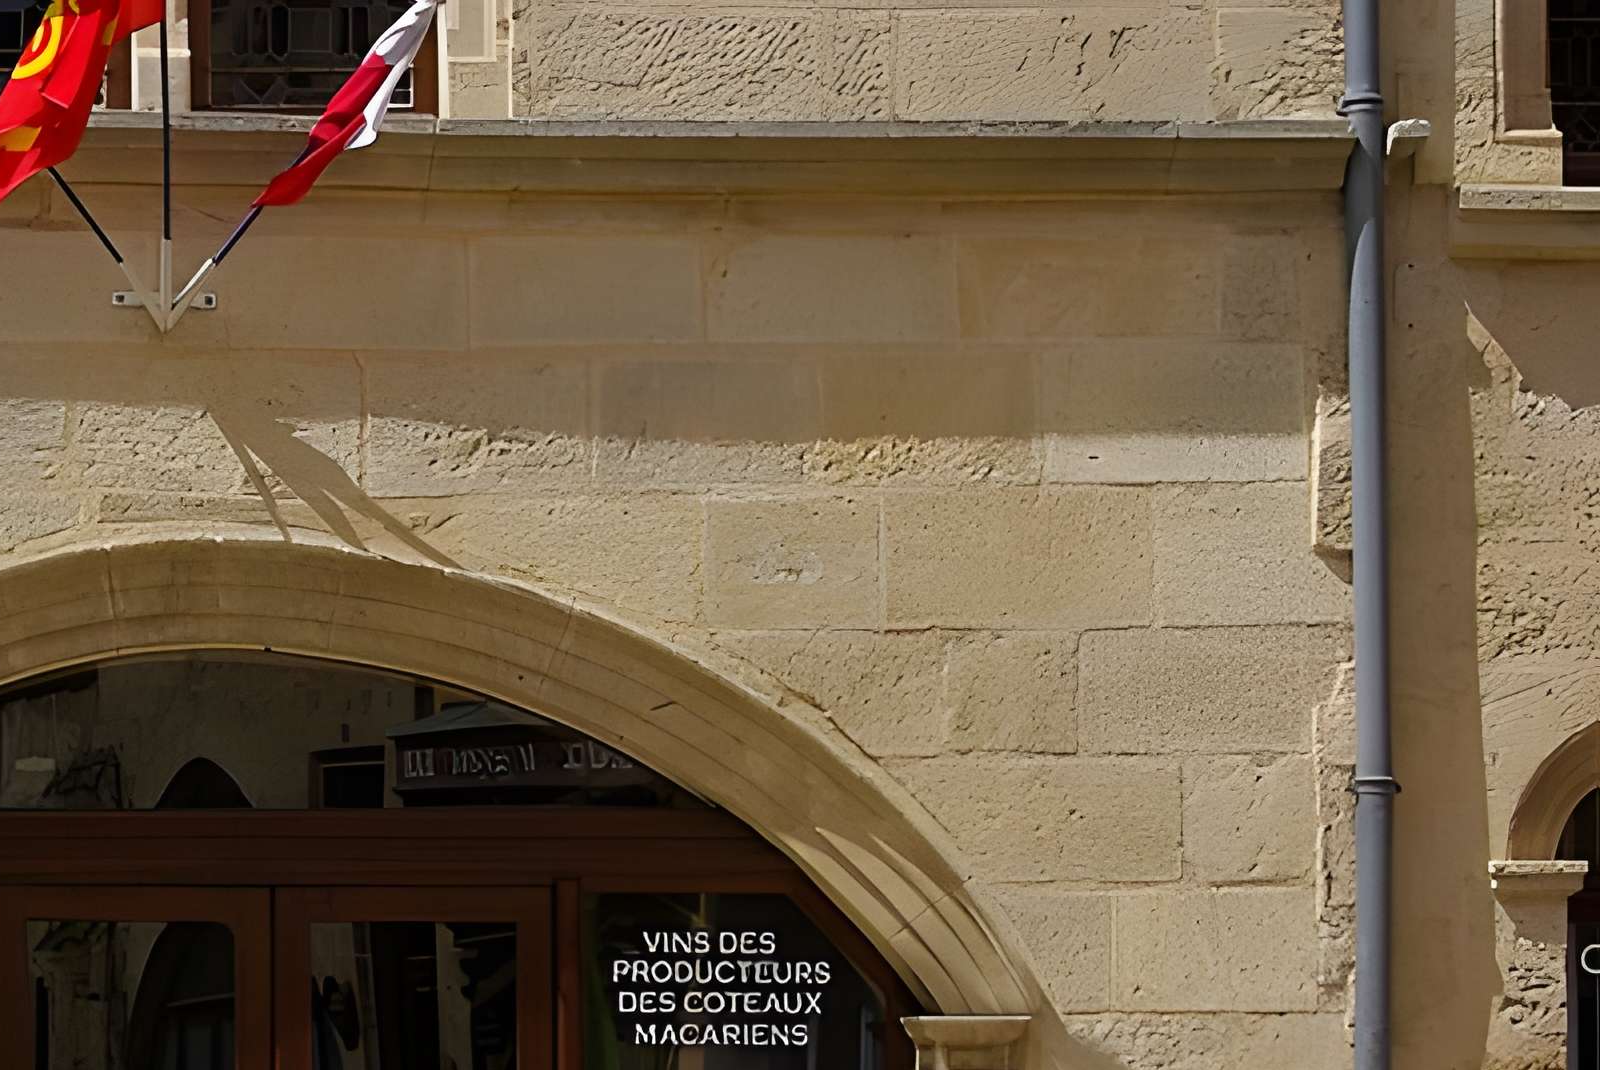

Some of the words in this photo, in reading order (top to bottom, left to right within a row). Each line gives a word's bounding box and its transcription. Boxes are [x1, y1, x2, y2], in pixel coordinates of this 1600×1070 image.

[643, 932, 709, 953] VINS
[720, 932, 775, 954] DES
[613, 960, 830, 984] PRODUCTEURS
[619, 992, 675, 1013] DES
[684, 992, 821, 1014] COTEAUX
[636, 1024, 807, 1045] MACARIENS
